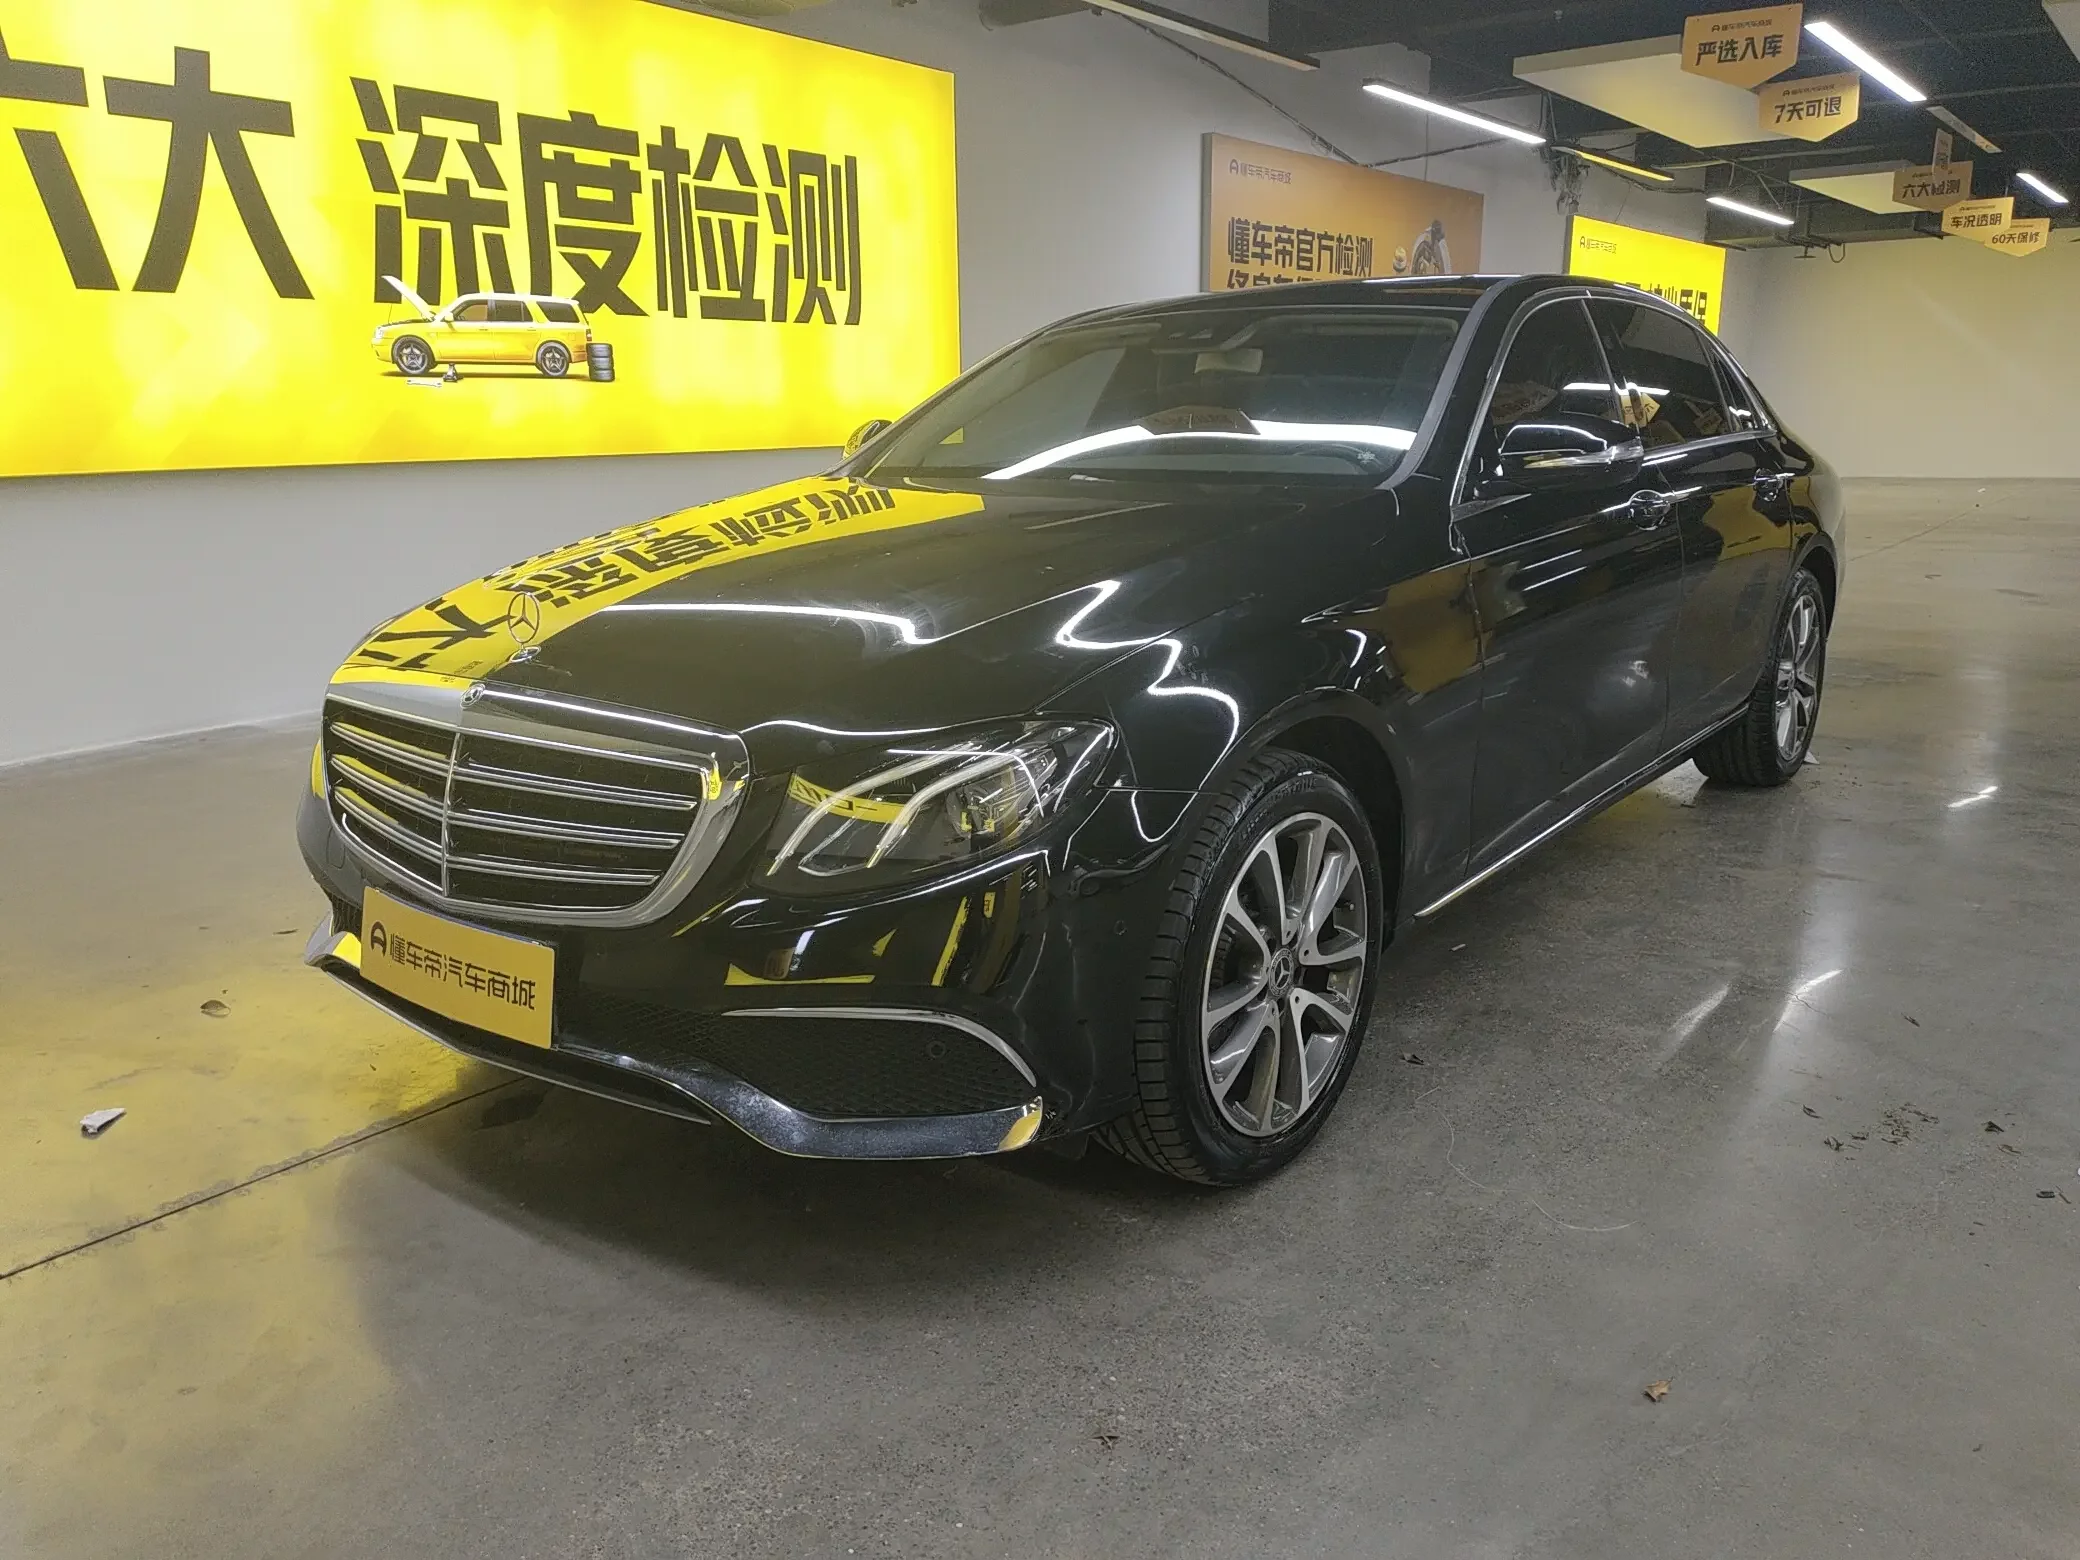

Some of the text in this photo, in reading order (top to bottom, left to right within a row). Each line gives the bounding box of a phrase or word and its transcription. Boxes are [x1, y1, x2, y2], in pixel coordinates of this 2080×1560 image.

[1695, 34, 1784, 66] 严选入库
[1774, 96, 1842, 123] 7天可退
[349, 75, 862, 326] 深度检测
[1950, 212, 2003, 228] 车况透明
[1227, 216, 1375, 278] 懂车帝官方检测
[1991, 231, 2041, 244] 60天保修
[389, 932, 536, 1011] 懂车帝汽车商城
